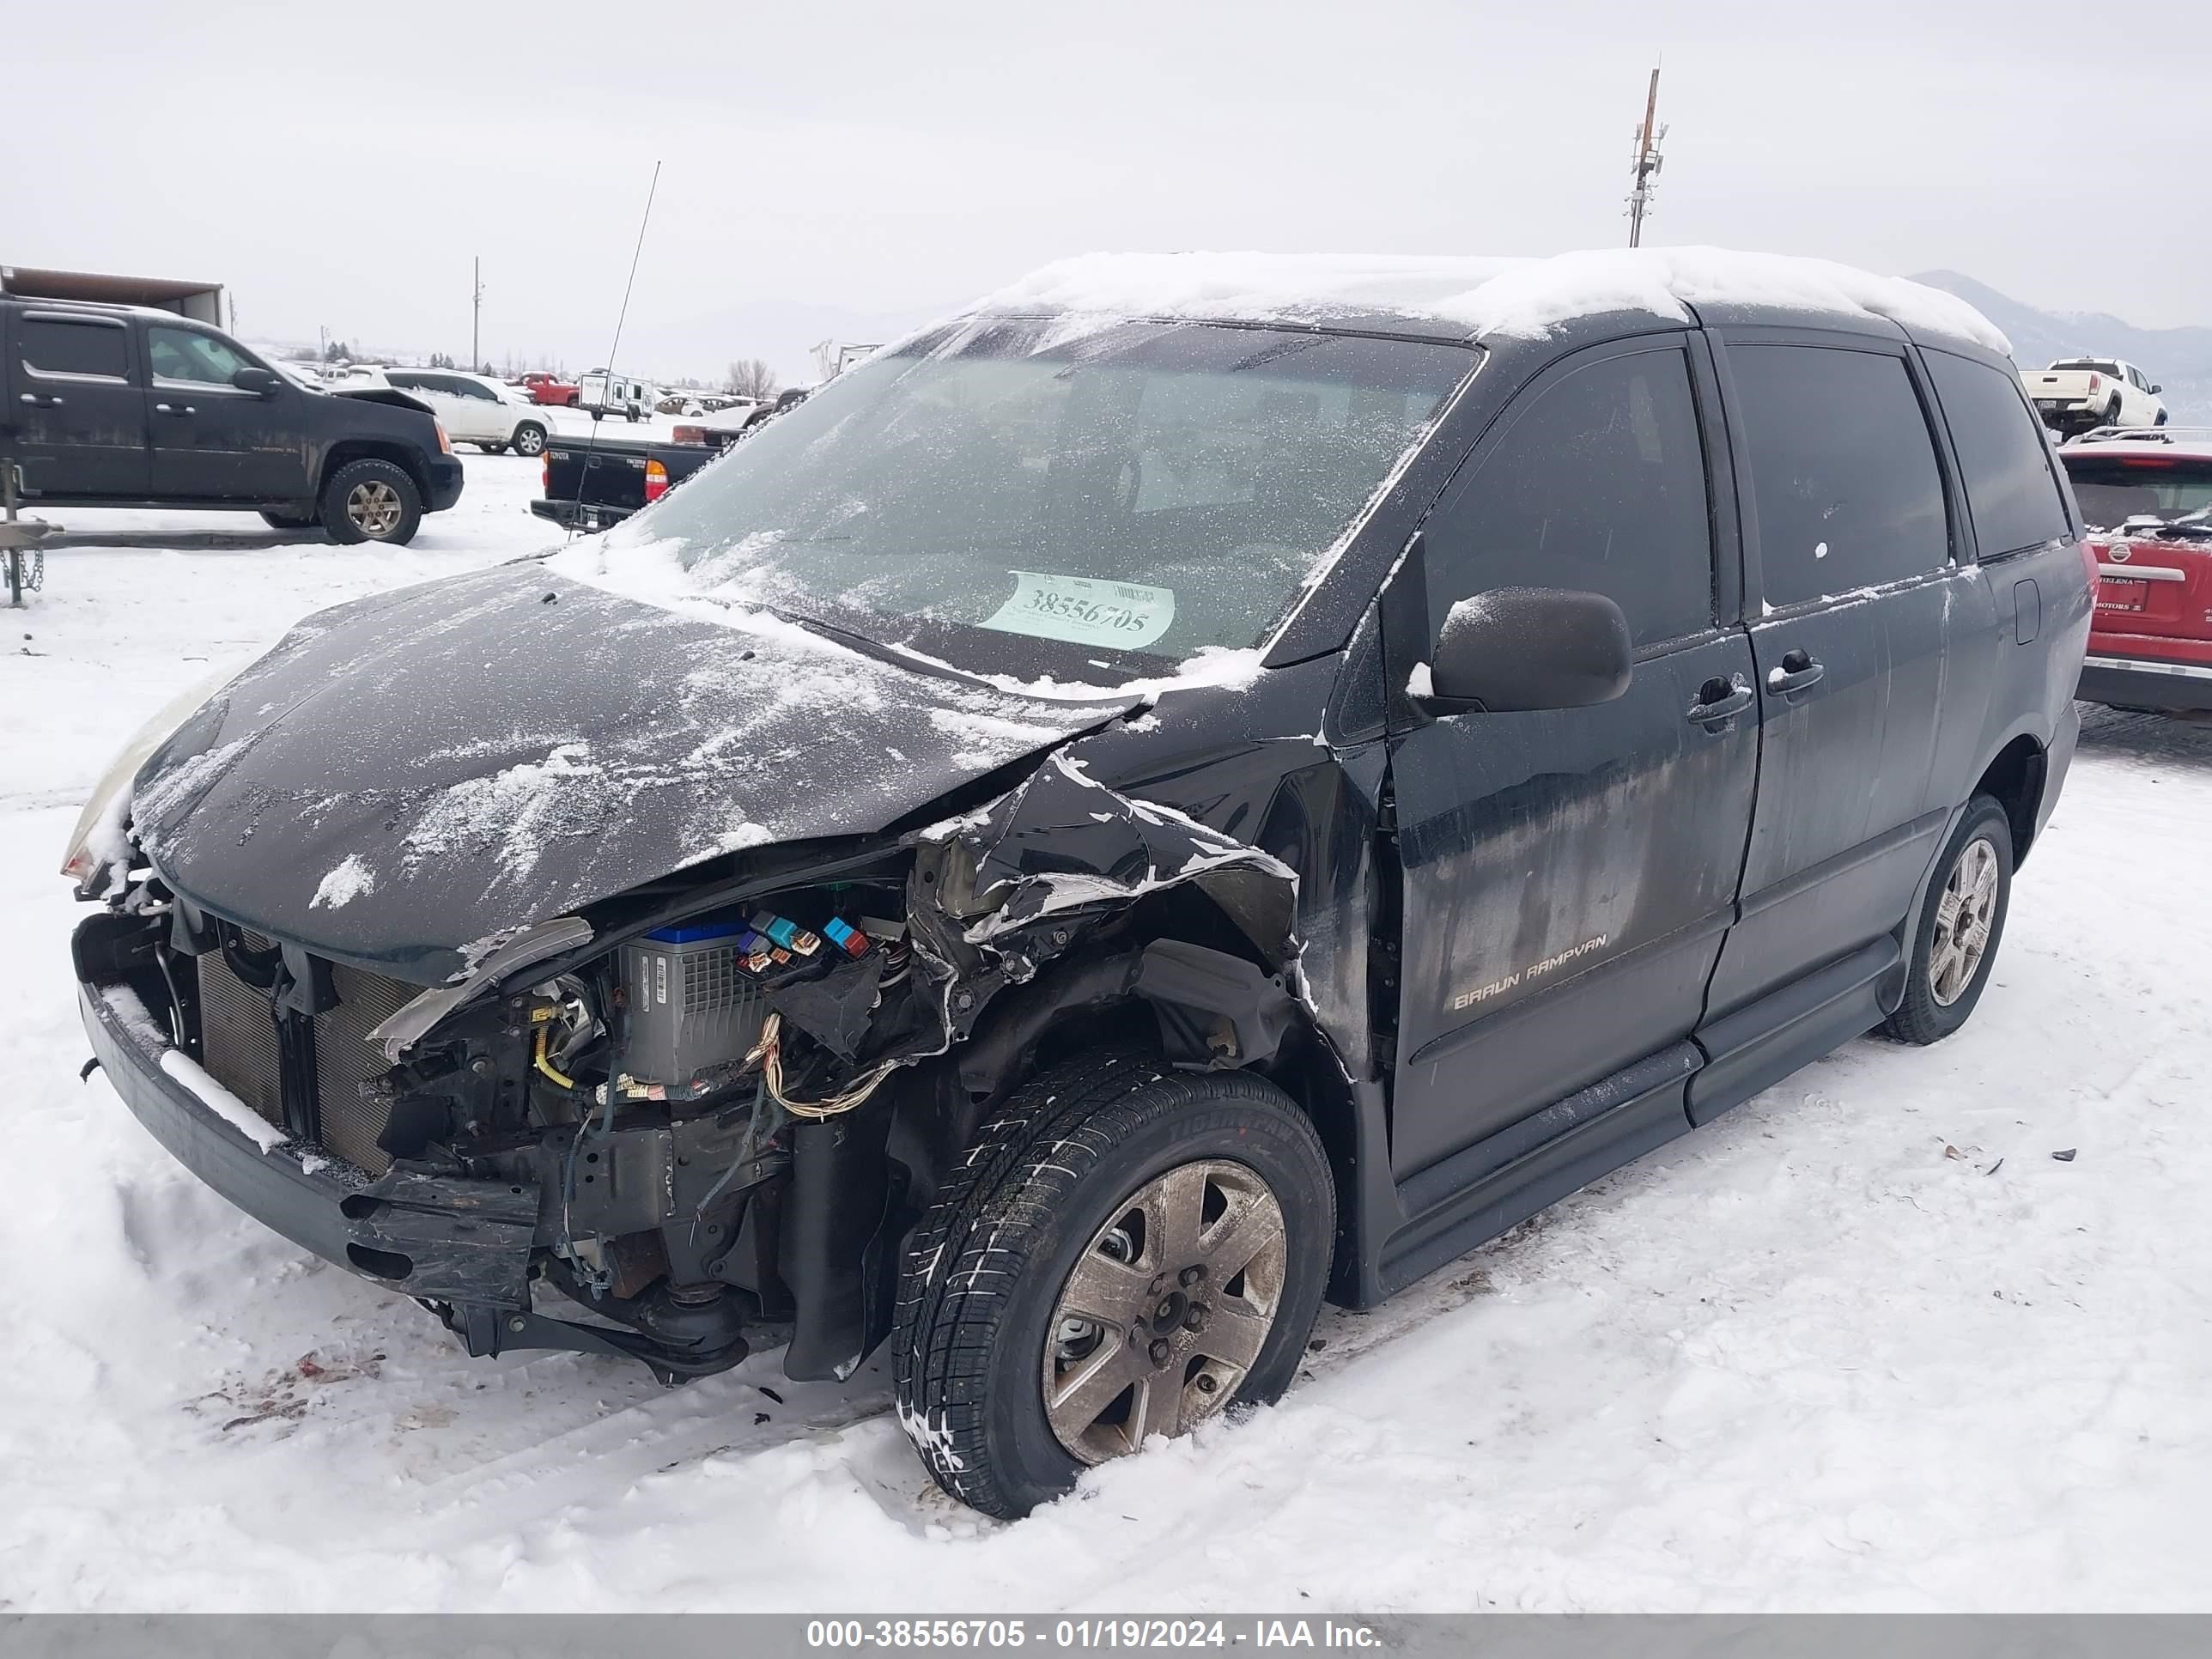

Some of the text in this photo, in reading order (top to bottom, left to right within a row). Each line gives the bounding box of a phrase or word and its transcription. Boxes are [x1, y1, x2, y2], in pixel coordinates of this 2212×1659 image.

[550, 451, 569, 461] TOYOTA
[1023, 589, 1149, 632] 38556705
[1454, 933, 1607, 1011] BRAUN RAMPVAN
